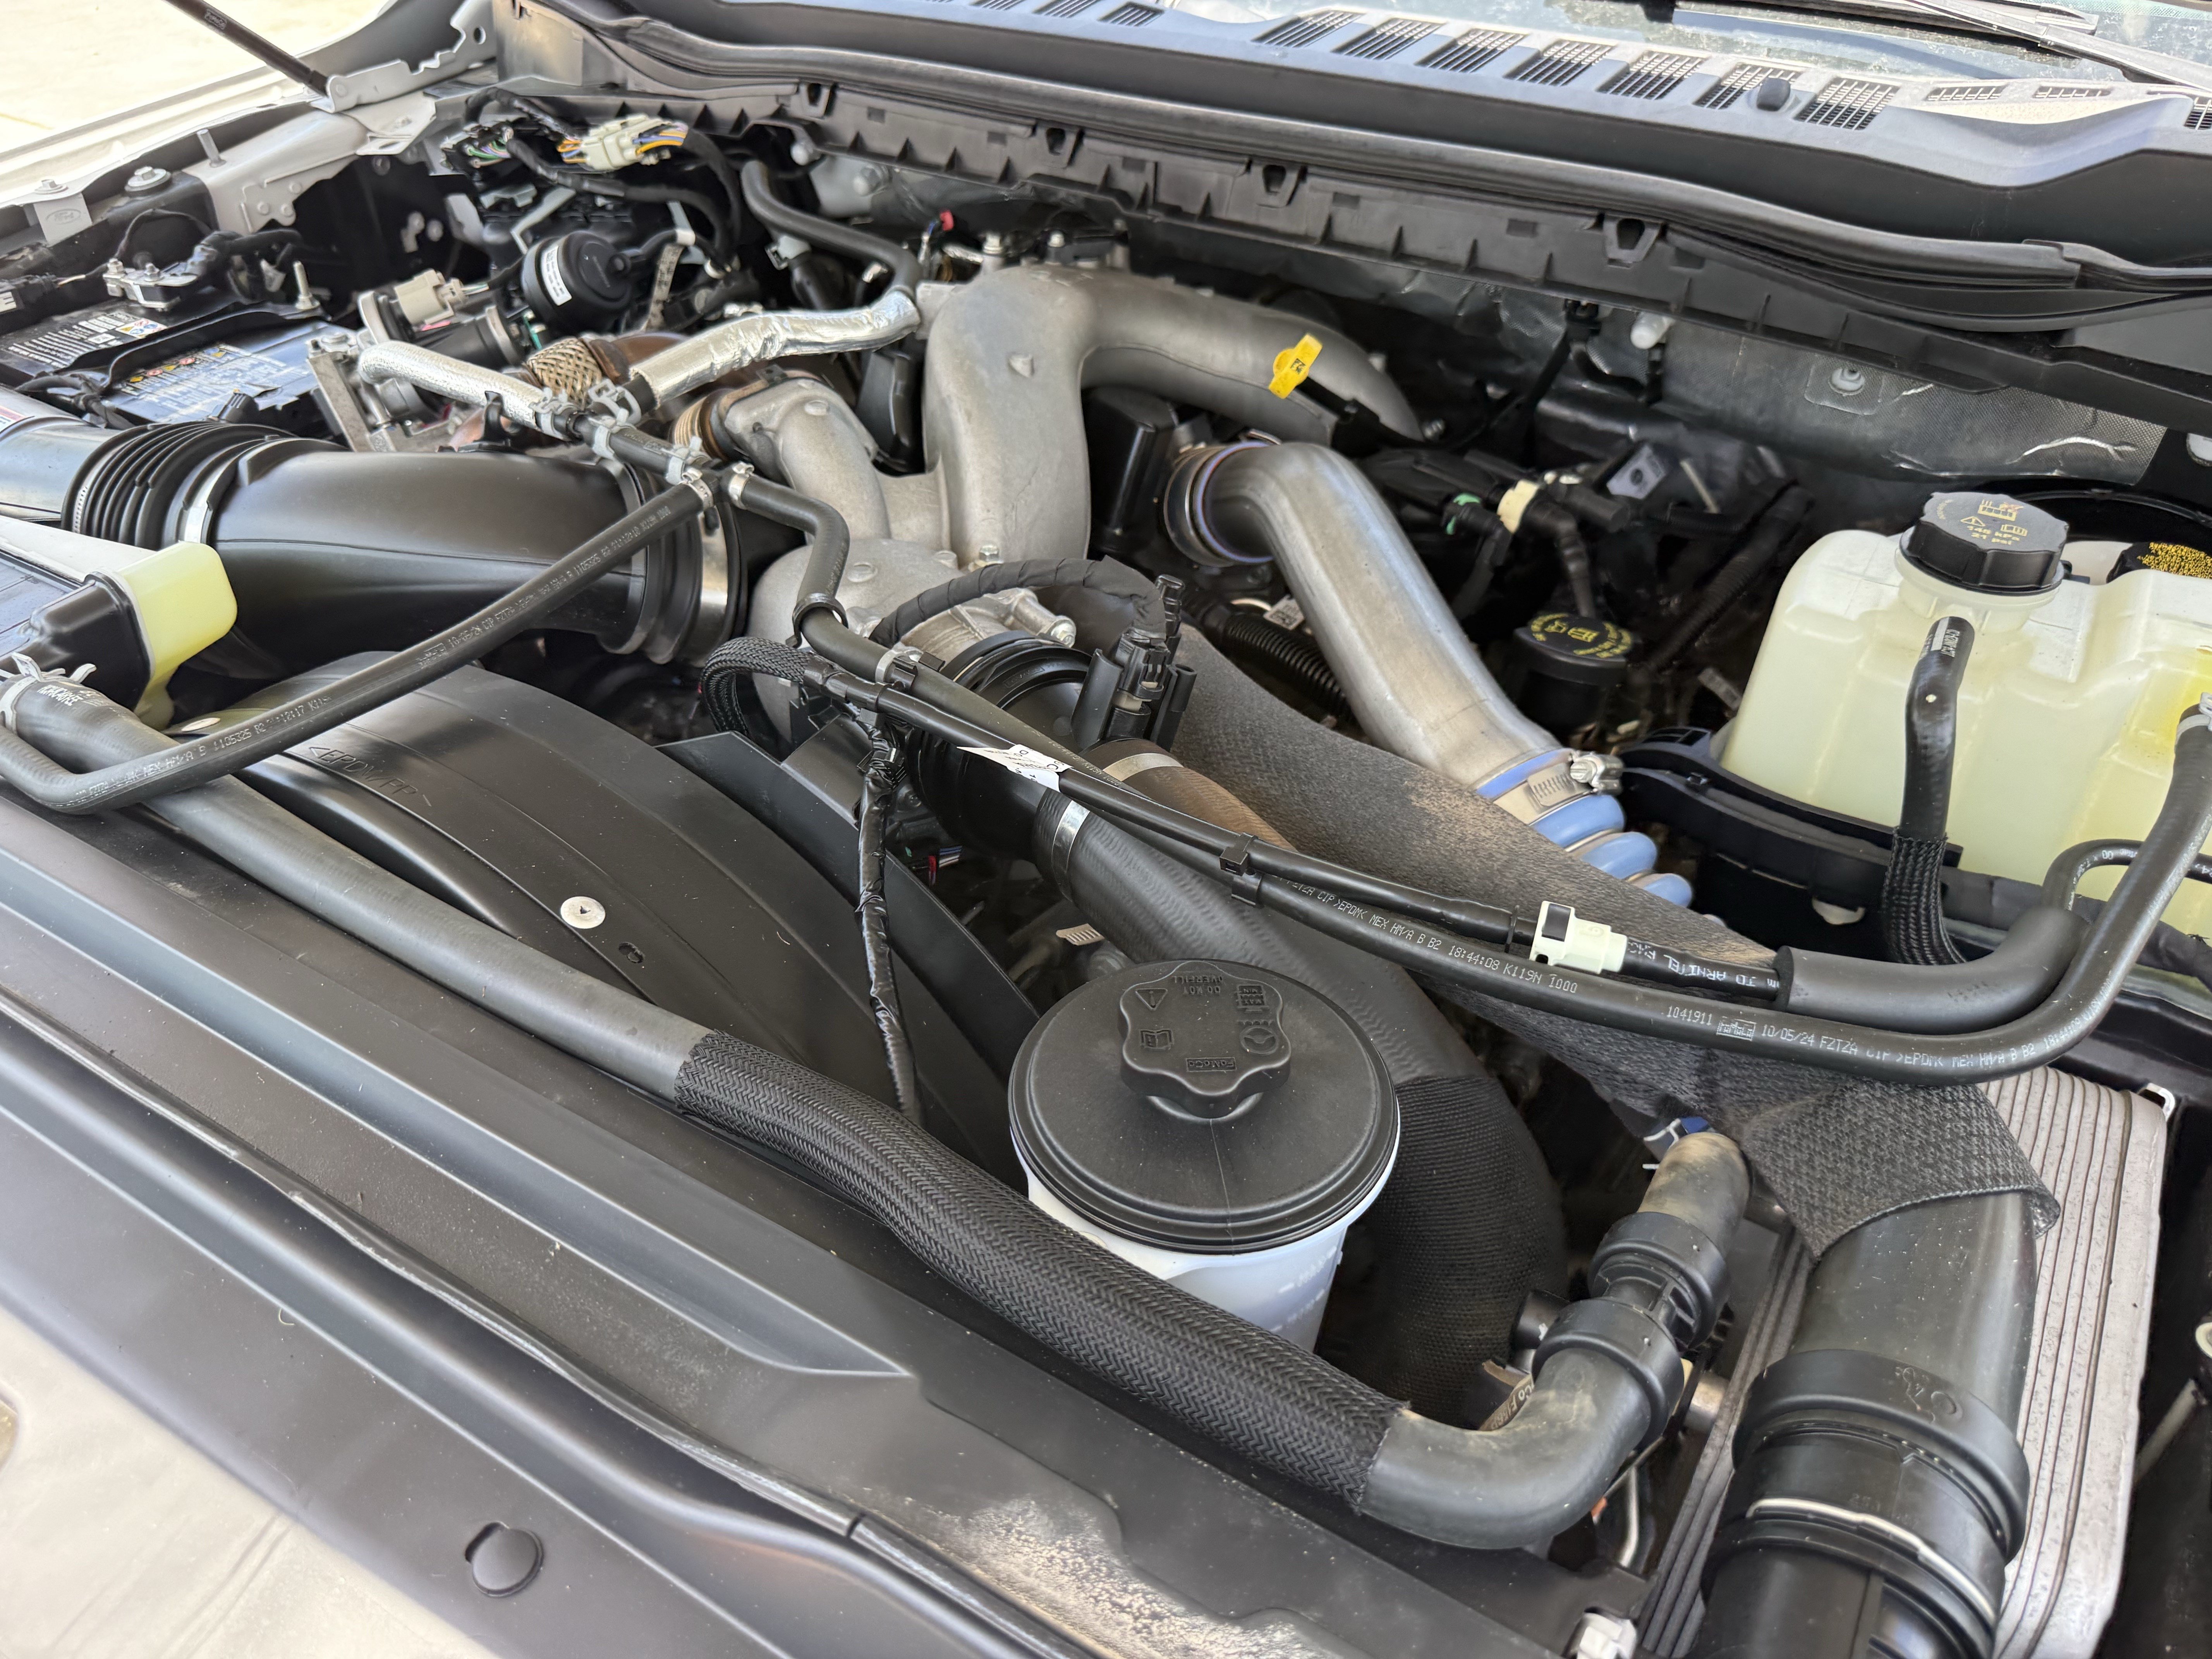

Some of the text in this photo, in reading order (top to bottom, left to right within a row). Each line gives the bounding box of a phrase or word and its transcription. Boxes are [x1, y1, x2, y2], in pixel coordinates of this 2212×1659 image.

[1994, 531, 2020, 541] kPa
[1316, 889, 1335, 905] CIP
[1372, 914, 1388, 930] MEX
[1390, 923, 1415, 940] HM/A
[1417, 933, 1425, 944] B
[1427, 938, 1442, 951] B2
[1449, 945, 1500, 971] 18:44:08
[1503, 963, 1542, 985] K119N
[1550, 974, 1578, 994] 1000
[1666, 1006, 1712, 1026] 1041911
[1762, 1025, 1815, 1046] 10/05/24
[1819, 1035, 1859, 1056] FZTZA
